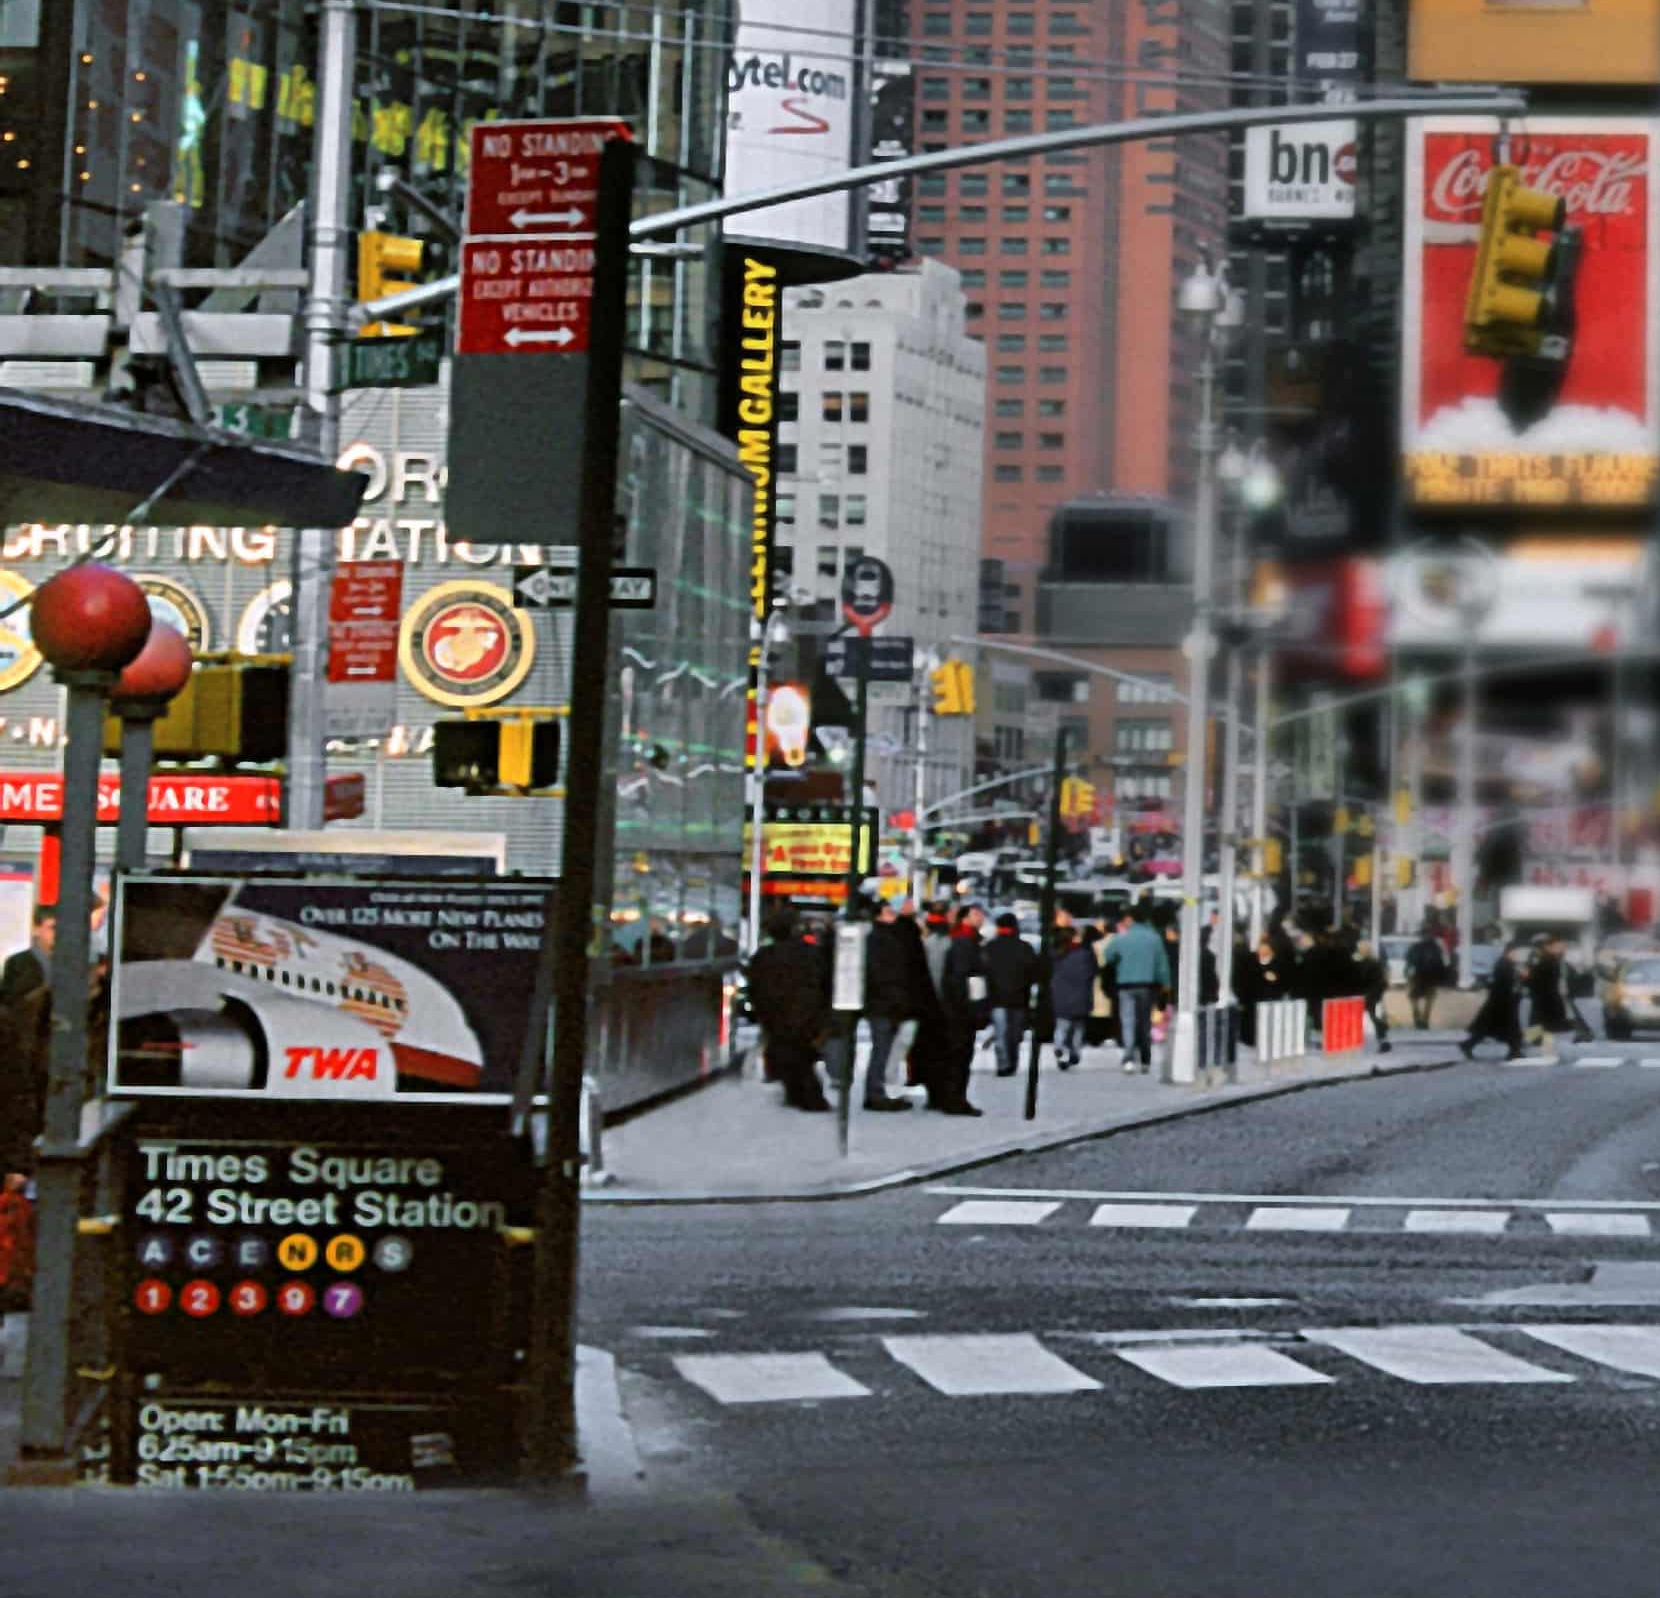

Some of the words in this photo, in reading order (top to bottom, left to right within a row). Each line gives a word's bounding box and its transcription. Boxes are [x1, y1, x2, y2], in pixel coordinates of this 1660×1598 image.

[483, 134, 512, 158] NO
[1269, 130, 1329, 185] bn
[1433, 150, 1648, 214] Coc-Cola
[472, 249, 502, 274] NO
[502, 301, 580, 323] VEHICLES
[738, 257, 778, 425] GALLERY
[611, 579, 645, 597] AY
[300, 906, 347, 926] OVER
[484, 909, 545, 928] PLANES
[282, 1046, 379, 1081] TWA
[138, 1146, 268, 1183] Times
[288, 1147, 444, 1190] Square
[135, 1188, 194, 1224] 42
[206, 1189, 339, 1226] Street
[353, 1190, 507, 1228] Station
[143, 1239, 167, 1264] A
[188, 1239, 213, 1264] C
[239, 1240, 261, 1264] E
[381, 1241, 403, 1265] S
